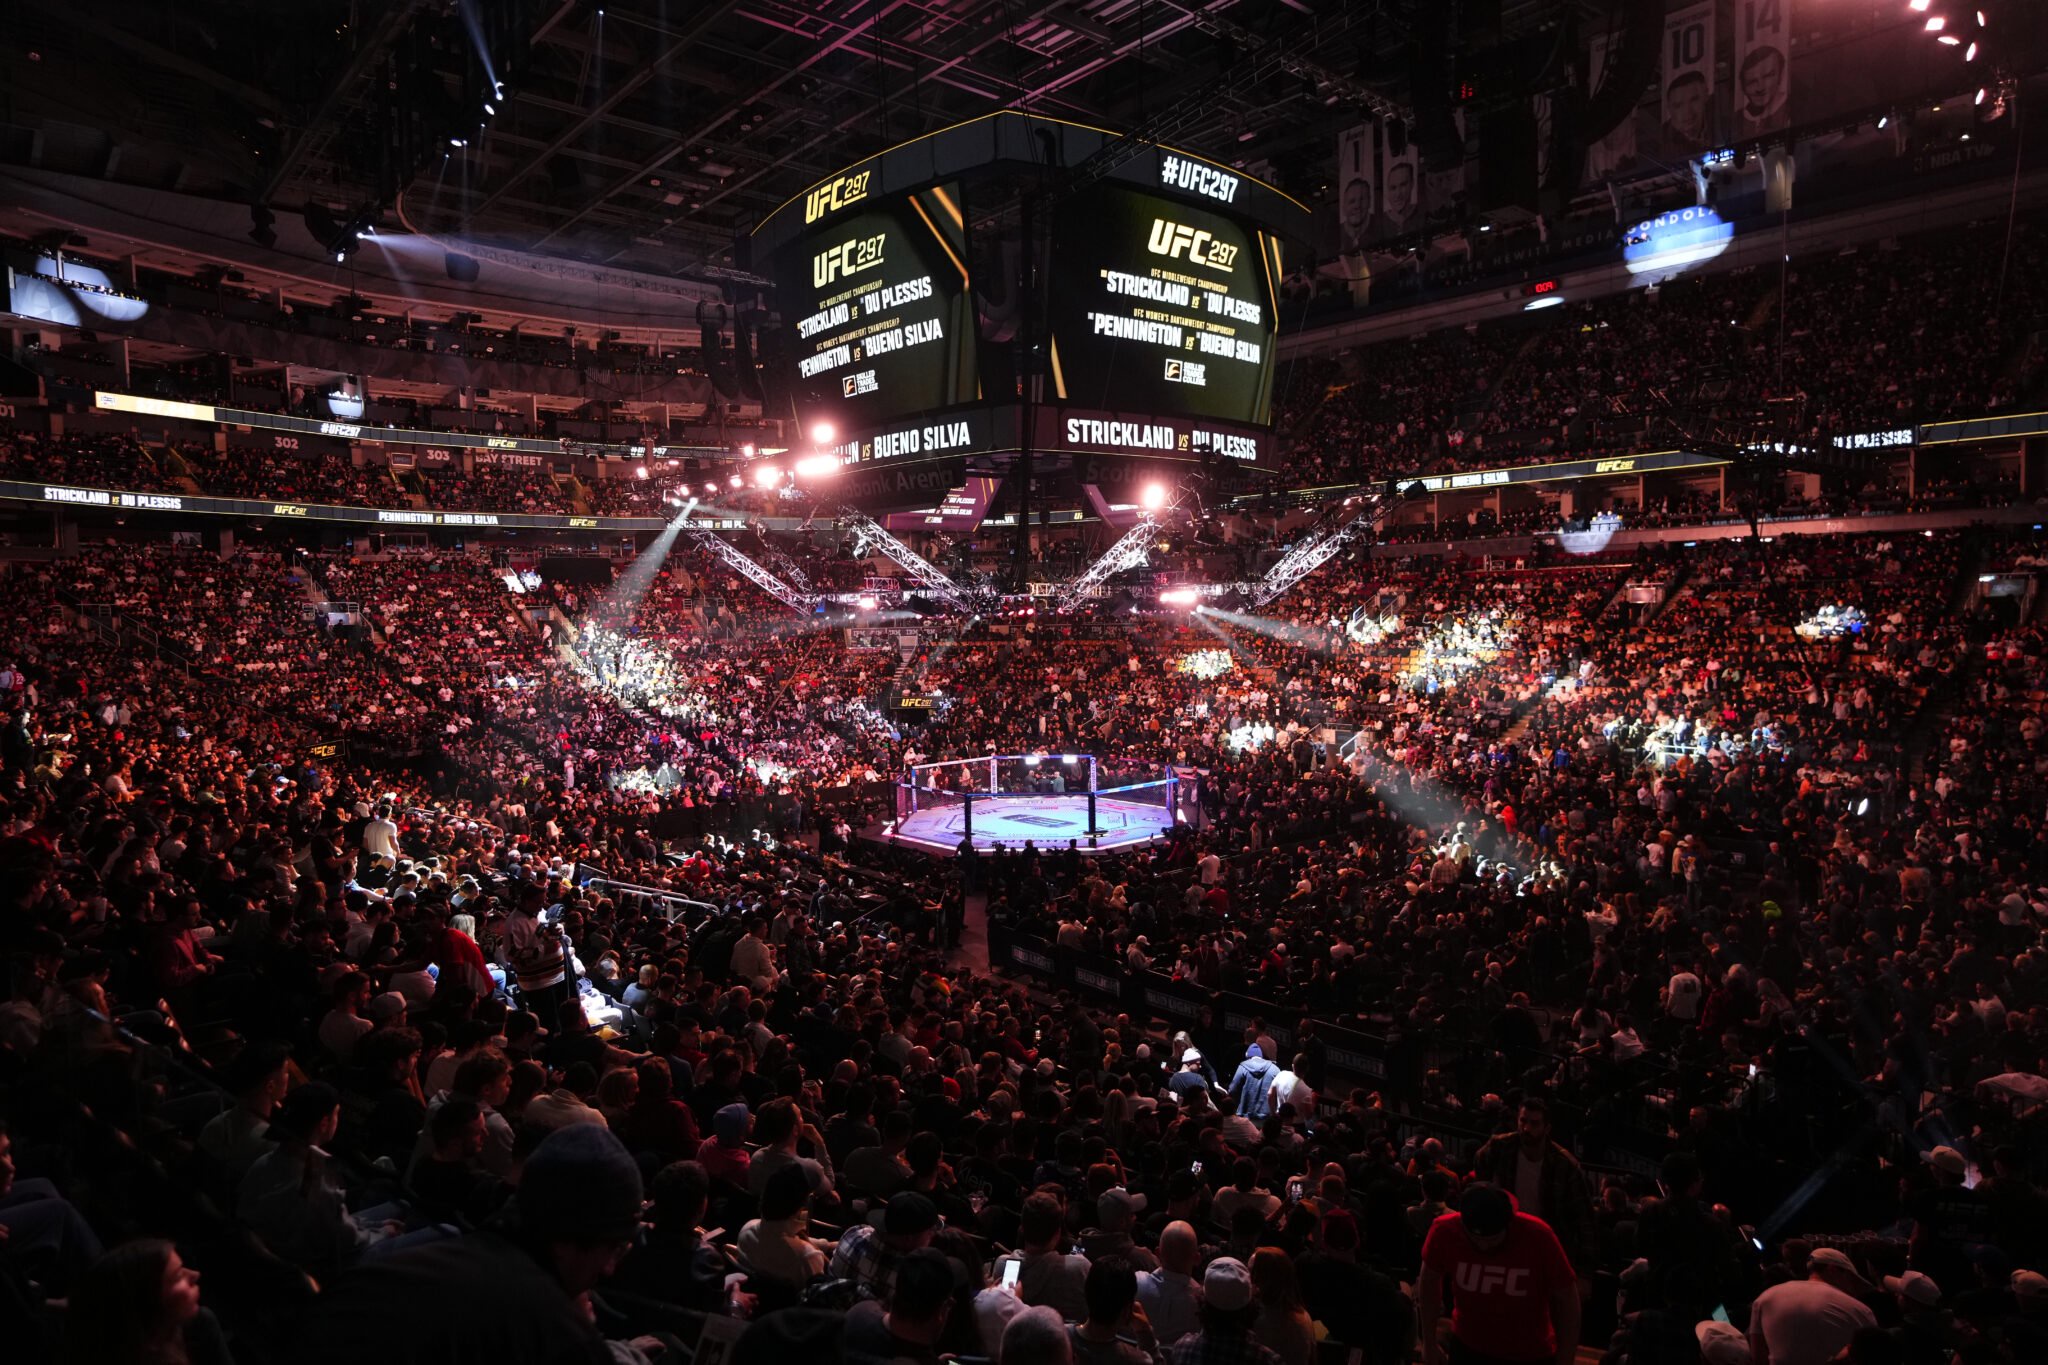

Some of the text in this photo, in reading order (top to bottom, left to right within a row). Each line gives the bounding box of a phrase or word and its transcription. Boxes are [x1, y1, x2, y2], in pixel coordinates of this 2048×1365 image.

[1672, 23, 1704, 69] 10
[1162, 155, 1239, 203] #UFC297
[1493, 244, 1550, 266] HEWITT
[1561, 229, 1615, 250] MEDIA
[1627, 204, 1718, 234] GONDOLA
[800, 303, 850, 340] STRICKLAND
[864, 291, 881, 315] DU
[881, 276, 933, 309] PLESSIS
[1106, 270, 1261, 325] STRICKLAND VS DU PLESSIS
[1133, 308, 1144, 318] UFC
[800, 344, 851, 379] PENNINGTON
[865, 328, 904, 357] BUENO
[905, 318, 944, 347] SILVA
[1094, 312, 1261, 364] PENNINGTON VS BUENO SILVA
[0, 404, 15, 418] 01
[274, 436, 299, 450] 302
[862, 443, 872, 461] VS
[874, 429, 920, 459] BUENO
[923, 421, 971, 451] SILVA
[1067, 418, 1174, 450] STRICKLAND
[1177, 434, 1189, 451] VS
[1213, 433, 1257, 460] PLESSIS
[427, 449, 450, 461] 303
[475, 453, 543, 466] BAY STREET
[896, 468, 954, 492] Arena
[44, 487, 110, 505] STRICKLAND
[121, 494, 135, 506] DU
[137, 496, 182, 510] PLESSIS
[378, 511, 434, 523] PENNINGTON
[443, 513, 473, 524] BUENO
[474, 515, 499, 525] SILVA
[721, 519, 732, 529] DU
[1077, 969, 1095, 984] BUD
[1146, 992, 1198, 1015] BUD LIGHT
[1327, 1048, 1384, 1076] UD LIGHT
[1456, 1261, 1531, 1296] UFC
